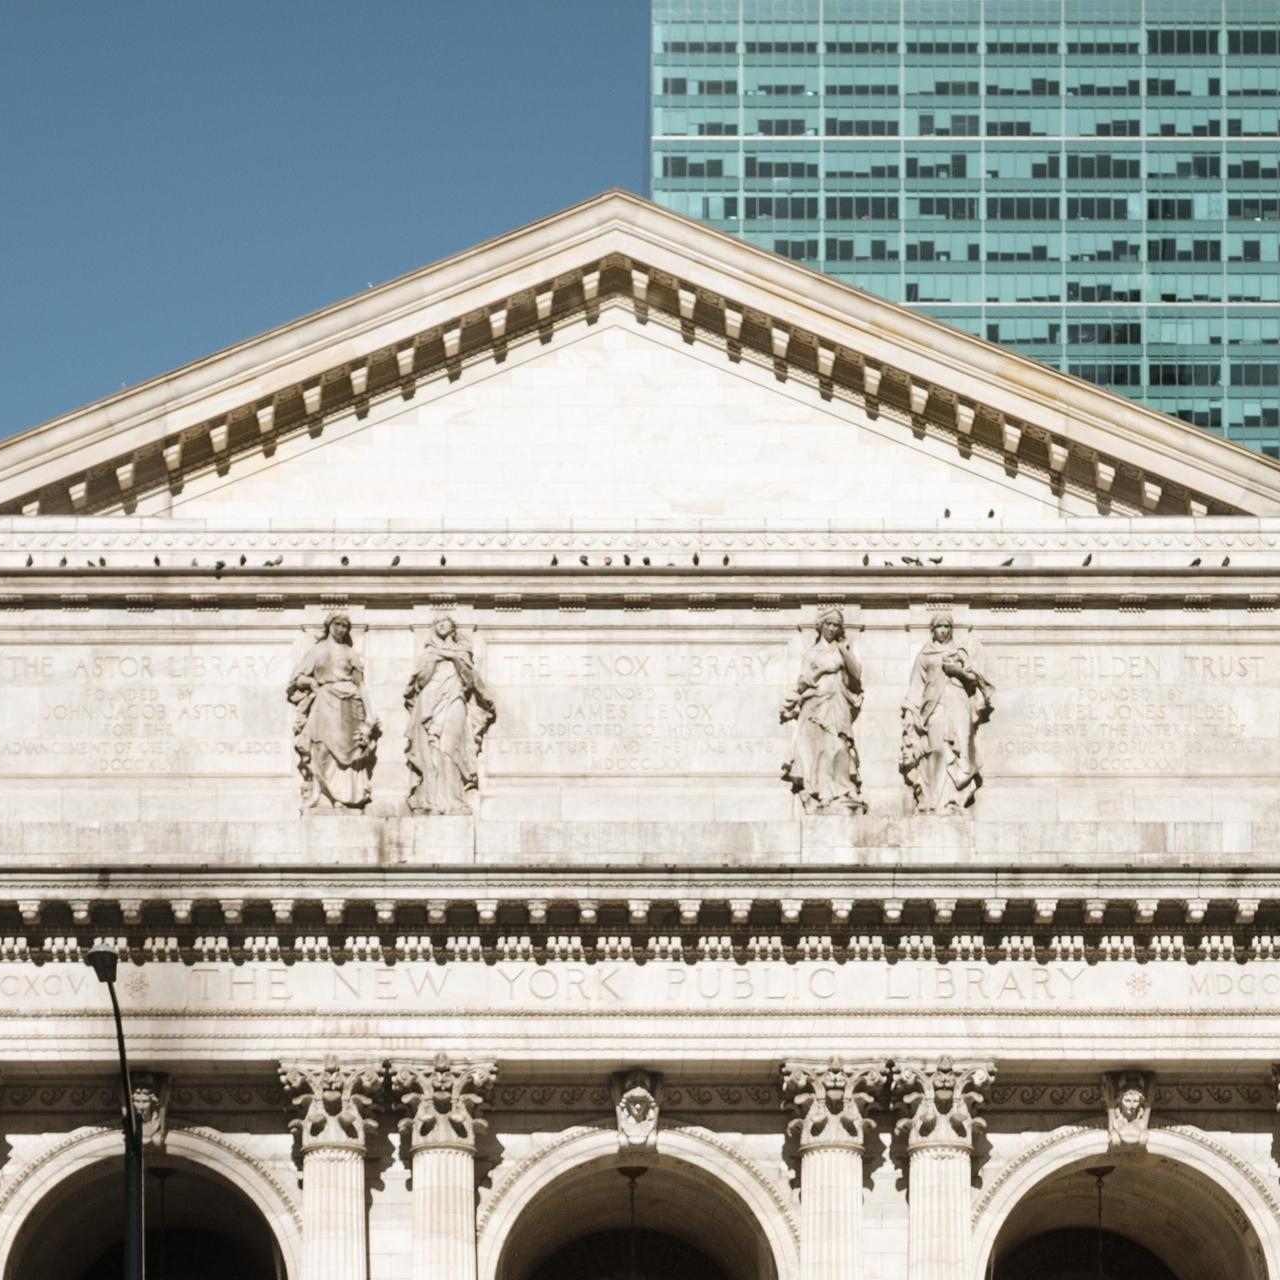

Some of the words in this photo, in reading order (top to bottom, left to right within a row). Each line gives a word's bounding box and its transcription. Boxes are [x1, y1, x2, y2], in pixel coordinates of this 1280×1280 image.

[6, 656, 53, 678] THE
[73, 656, 154, 678] ASTOR
[169, 656, 276, 678] LIBRARY
[504, 656, 551, 678] THE
[567, 656, 650, 678] LENOX
[665, 656, 772, 678] LIBRARY
[997, 656, 1046, 678] THE
[1070, 656, 1161, 678] TILDEN
[1184, 656, 1265, 678] TRUST
[86, 688, 159, 701] FOUNDED
[177, 688, 194, 701] BY
[583, 688, 656, 701] FOUNDED
[674, 688, 691, 701] BY
[1078, 688, 1151, 701] FOUNDED
[42, 704, 93, 720] JOHN
[104, 704, 166, 720] JACOB
[179, 704, 240, 720] ASTOR
[562, 704, 628, 720] JAMES
[647, 704, 713, 720] LENOX
[1107, 704, 1166, 720] JONES
[104, 724, 134, 737] FOR
[143, 724, 174, 737] THE
[1100, 724, 1129, 737] THE
[191, 968, 293, 1000] THE
[332, 968, 452, 1000] NEW
[497, 968, 623, 1000] YORK
[666, 968, 836, 1000] PUBLIC
[885, 968, 1087, 1000] LIBRARY
